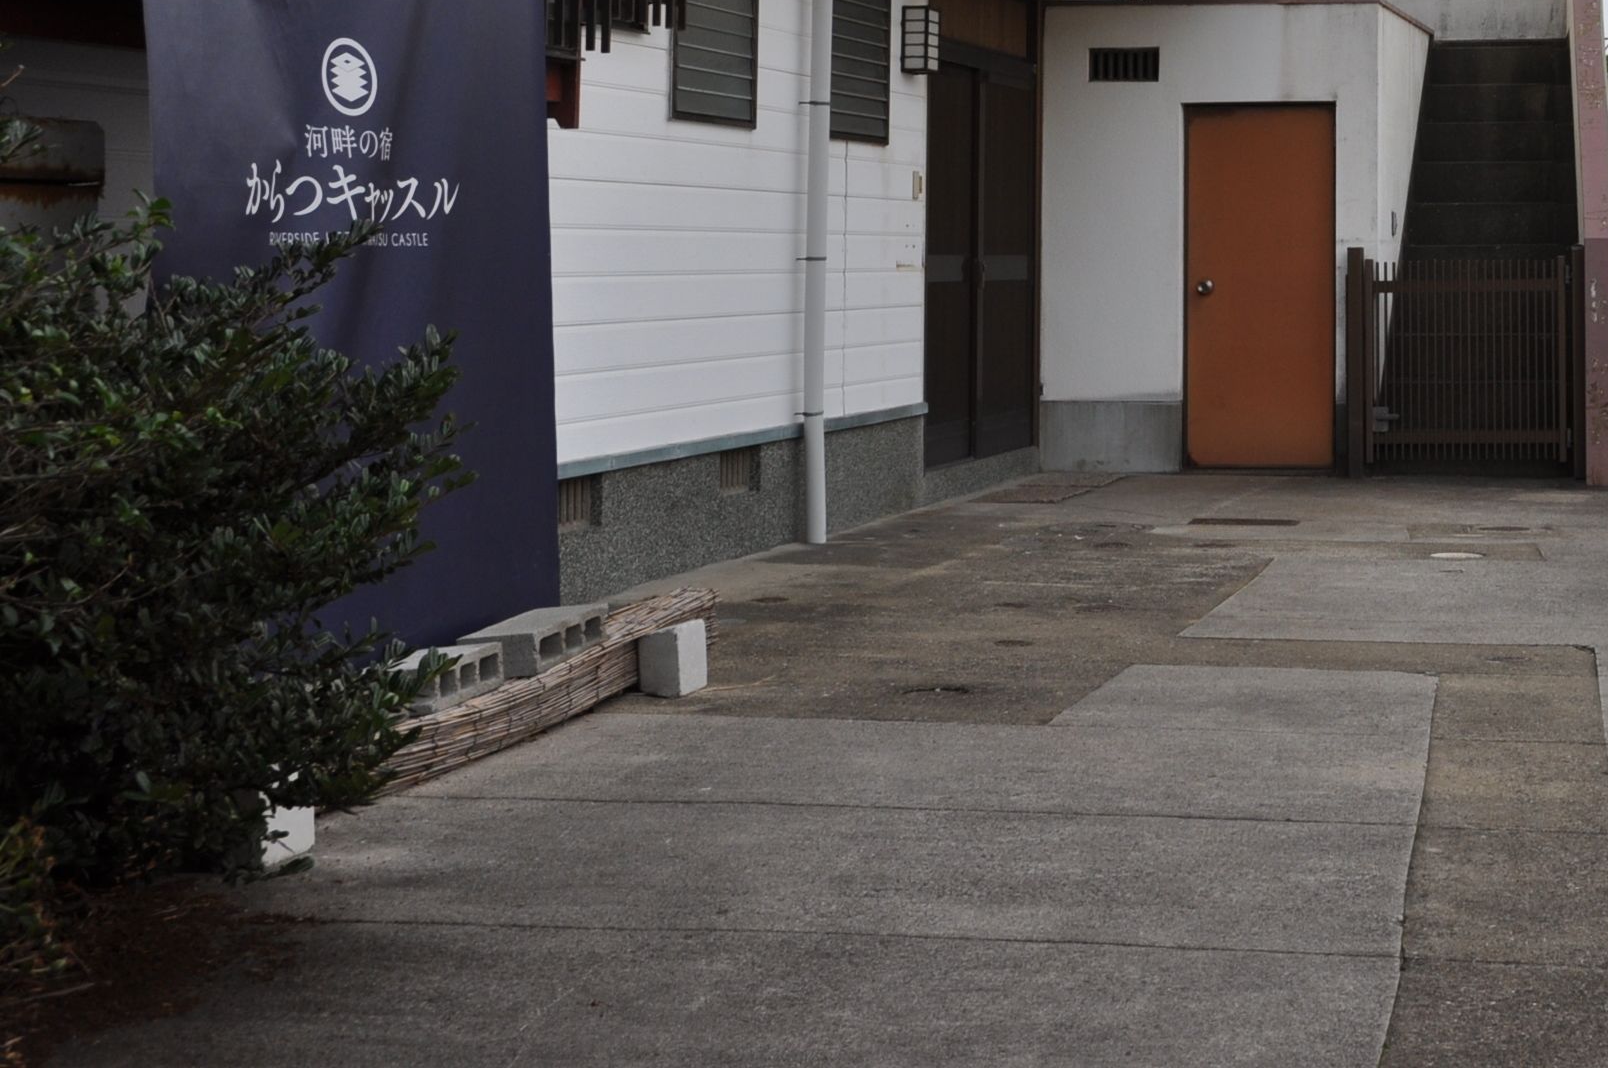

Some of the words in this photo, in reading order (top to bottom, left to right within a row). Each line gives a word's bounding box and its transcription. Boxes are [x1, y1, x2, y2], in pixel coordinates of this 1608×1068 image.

[304, 123, 393, 161] 河畔の宿
[245, 159, 460, 225] からつキャッスル
[391, 232, 429, 247] CASTLE
